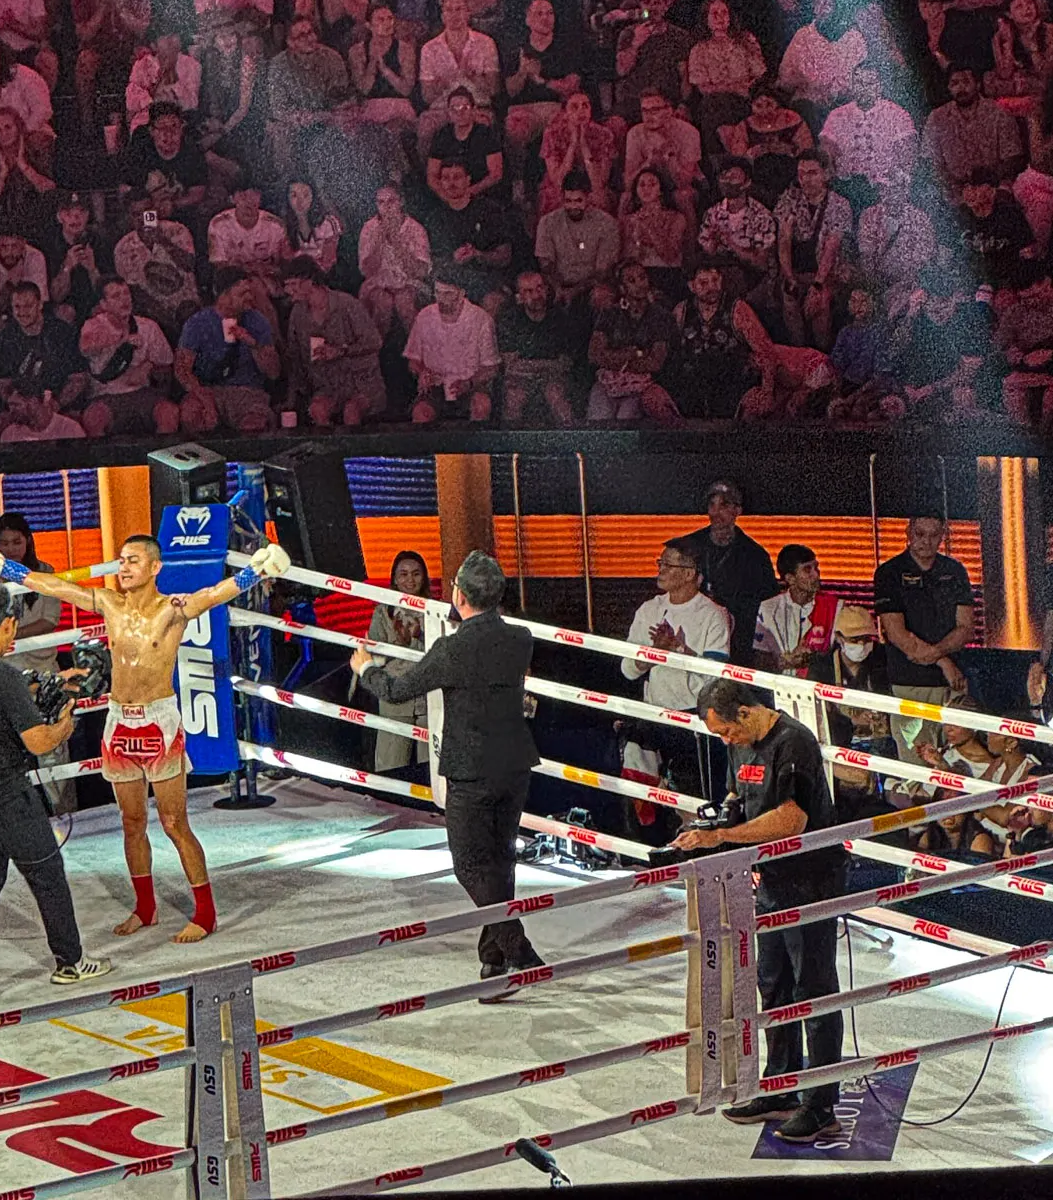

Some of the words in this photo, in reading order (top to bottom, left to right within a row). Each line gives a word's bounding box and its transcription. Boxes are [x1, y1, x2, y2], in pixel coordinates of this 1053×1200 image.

[170, 535, 211, 546] RWS
[325, 576, 352, 590] RWS
[555, 628, 584, 646] RWS
[636, 646, 668, 663] RWS
[722, 664, 756, 682] RWS
[814, 682, 847, 700] RWS
[339, 708, 366, 723] RWS
[412, 726, 429, 742] RW
[999, 718, 1037, 737] RWS
[112, 737, 163, 756] RWS
[835, 748, 871, 766] RWS
[737, 763, 766, 785] RWS
[929, 770, 966, 788] RWS
[647, 787, 679, 805] RWS
[997, 776, 1040, 800] RWS
[567, 827, 597, 845] RWS
[757, 837, 802, 864] RWS
[912, 854, 946, 872] RWS
[634, 866, 679, 888] RWS
[1008, 876, 1047, 897] RWS
[876, 882, 920, 903] RWS
[506, 893, 554, 916] RWS
[756, 910, 800, 930] RWS
[914, 920, 950, 940] RWS
[378, 922, 427, 946] RWS
[706, 940, 717, 969] GSV
[739, 929, 749, 968] RWS
[250, 952, 296, 974] RWS
[505, 966, 554, 989] RWS
[888, 974, 932, 996] RWS
[109, 982, 160, 1005] RWS
[378, 996, 426, 1020] RWS
[768, 1002, 812, 1024] RWS
[644, 1032, 691, 1055] RWS
[706, 1031, 717, 1060] GSV
[741, 1019, 752, 1056] RWS
[108, 1057, 160, 1081] RWS
[242, 1052, 253, 1090] RWS
[874, 1050, 919, 1071] RWS
[204, 1065, 216, 1096] GSV
[519, 1062, 566, 1086] RWS
[759, 1074, 799, 1092] RWS
[629, 1101, 678, 1126] RWS
[122, 1155, 175, 1180] RWS
[207, 1156, 219, 1186] GSV
[250, 1143, 262, 1182] RWS
